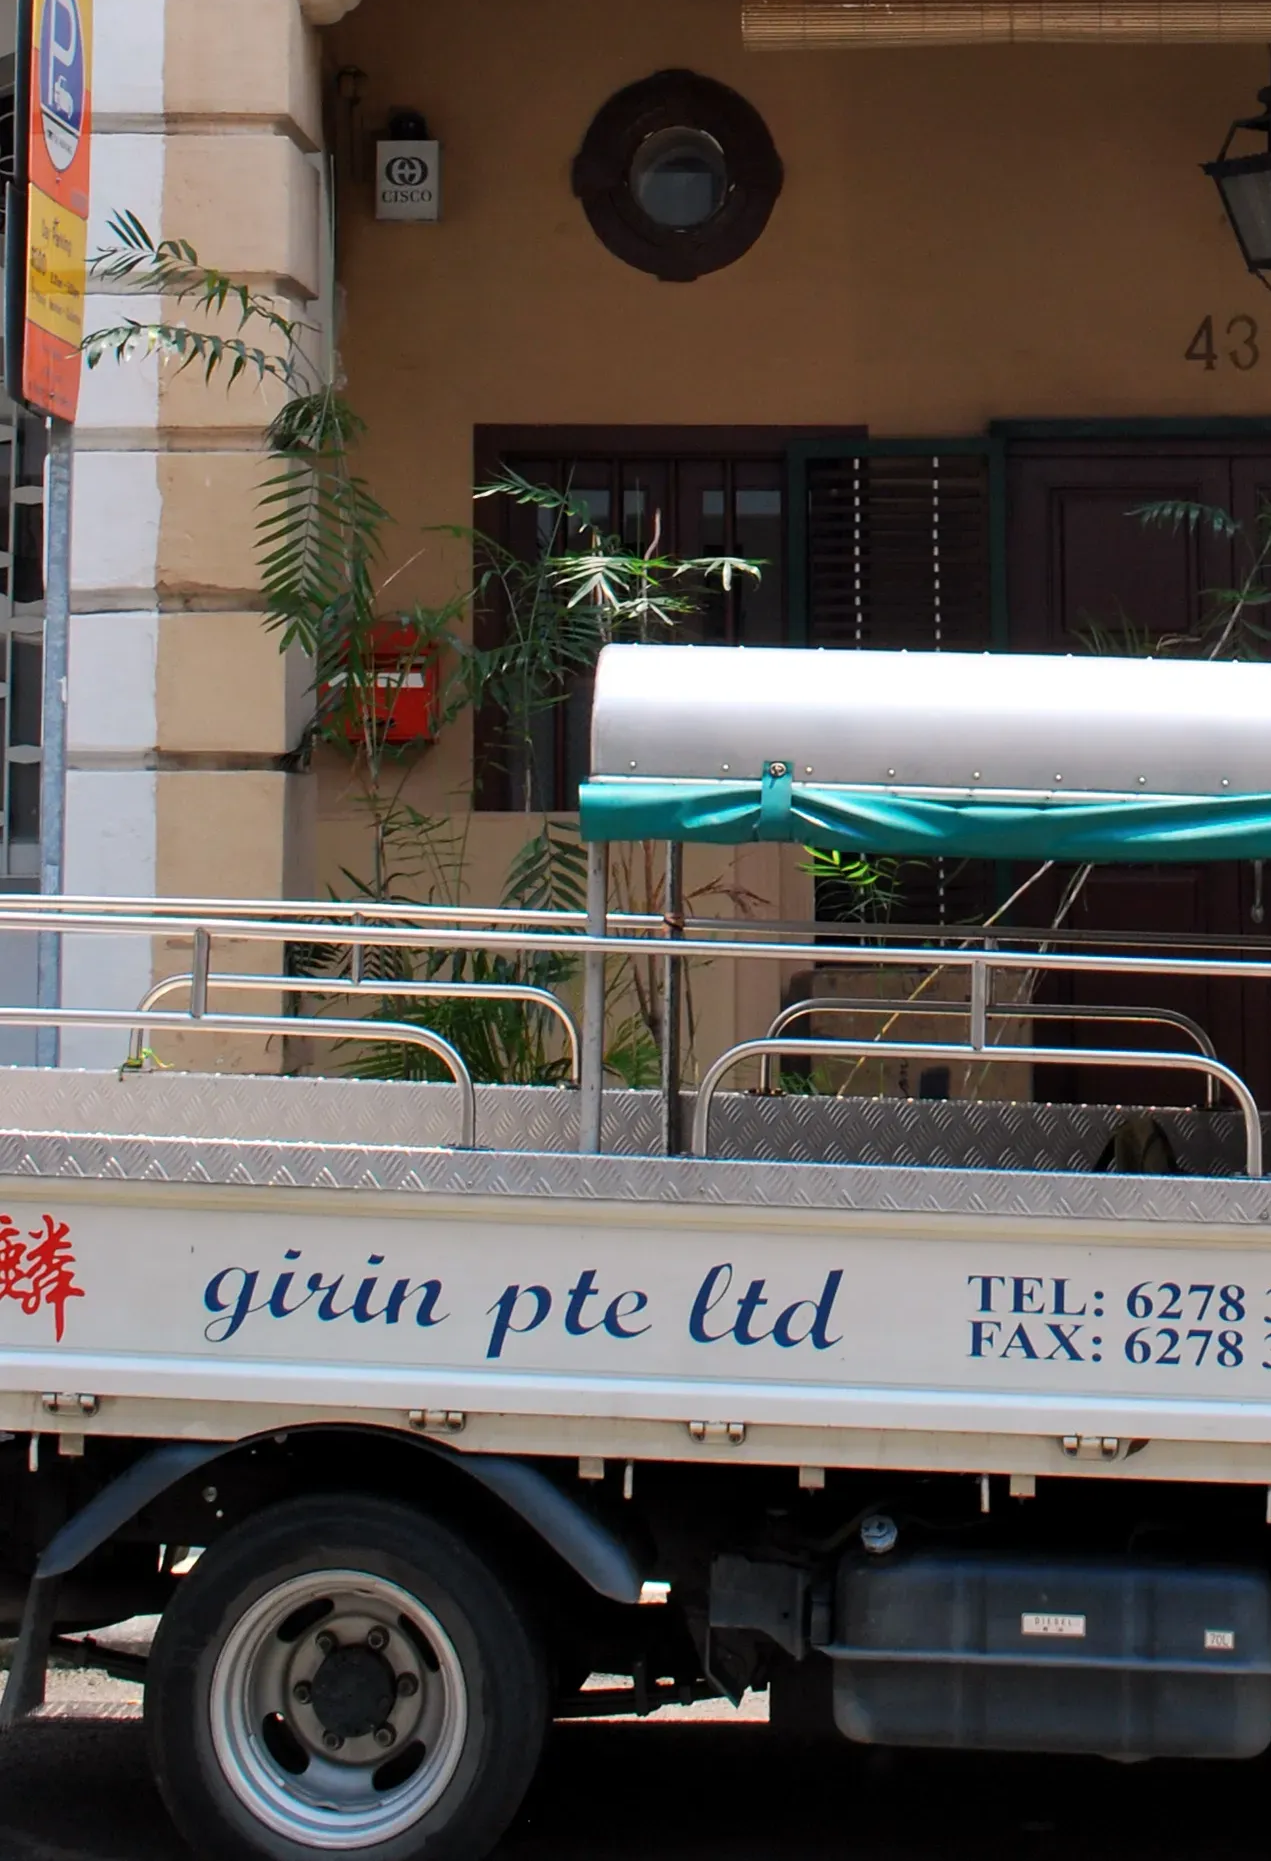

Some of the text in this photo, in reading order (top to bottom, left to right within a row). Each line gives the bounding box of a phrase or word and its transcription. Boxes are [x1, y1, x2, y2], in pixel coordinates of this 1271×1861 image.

[382, 189, 432, 203] CISCO
[1184, 314, 1260, 371] 43
[203, 1249, 845, 1360] girin pte ltd
[967, 1275, 1105, 1317] TEL:
[1125, 1281, 1246, 1322] 6278
[966, 1321, 1104, 1363] FAX:
[1124, 1327, 1245, 1368] 6278
